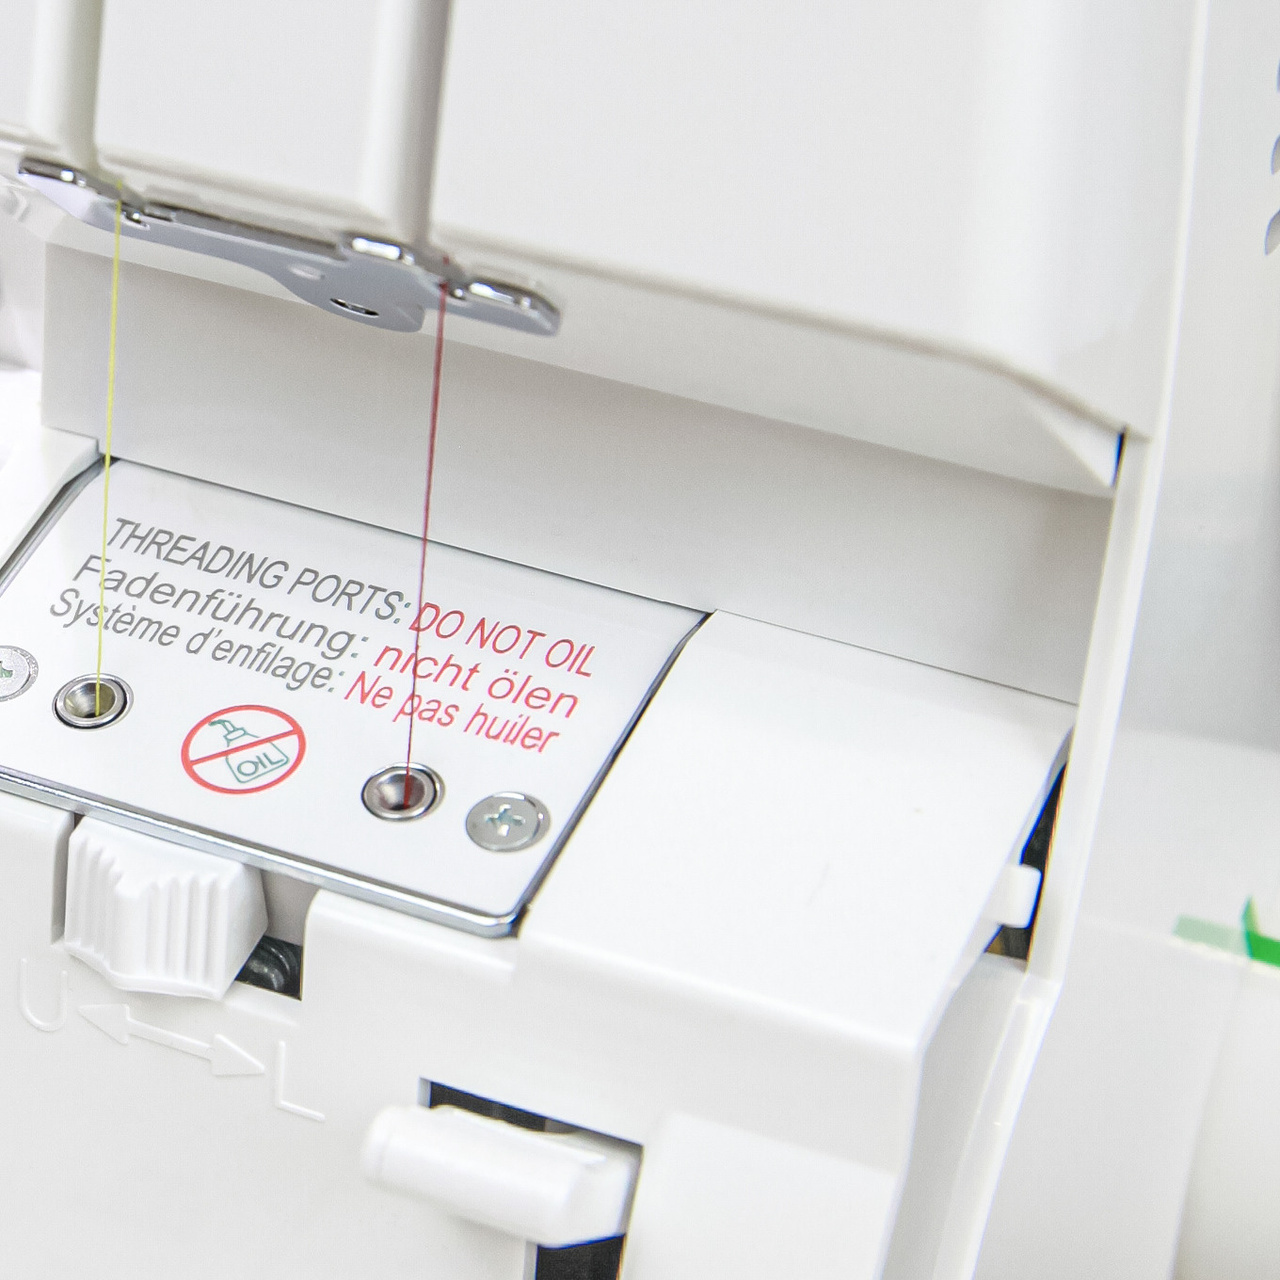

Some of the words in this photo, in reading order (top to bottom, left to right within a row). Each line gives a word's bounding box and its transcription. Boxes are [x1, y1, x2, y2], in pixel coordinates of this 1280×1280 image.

[49, 587, 180, 647] Système
[343, 670, 394, 709] Ne
[392, 692, 460, 727] pas
[463, 703, 560, 753] huiler
[72, 554, 368, 661] Fadenführung:
[373, 643, 482, 691] nicht
[487, 668, 579, 718] ölen
[106, 517, 289, 589] THREADING
[287, 567, 411, 624] PORTS:
[408, 601, 465, 639] DO
[465, 617, 547, 659] NOT
[545, 638, 596, 678] OIL
[236, 752, 285, 776] OIL
